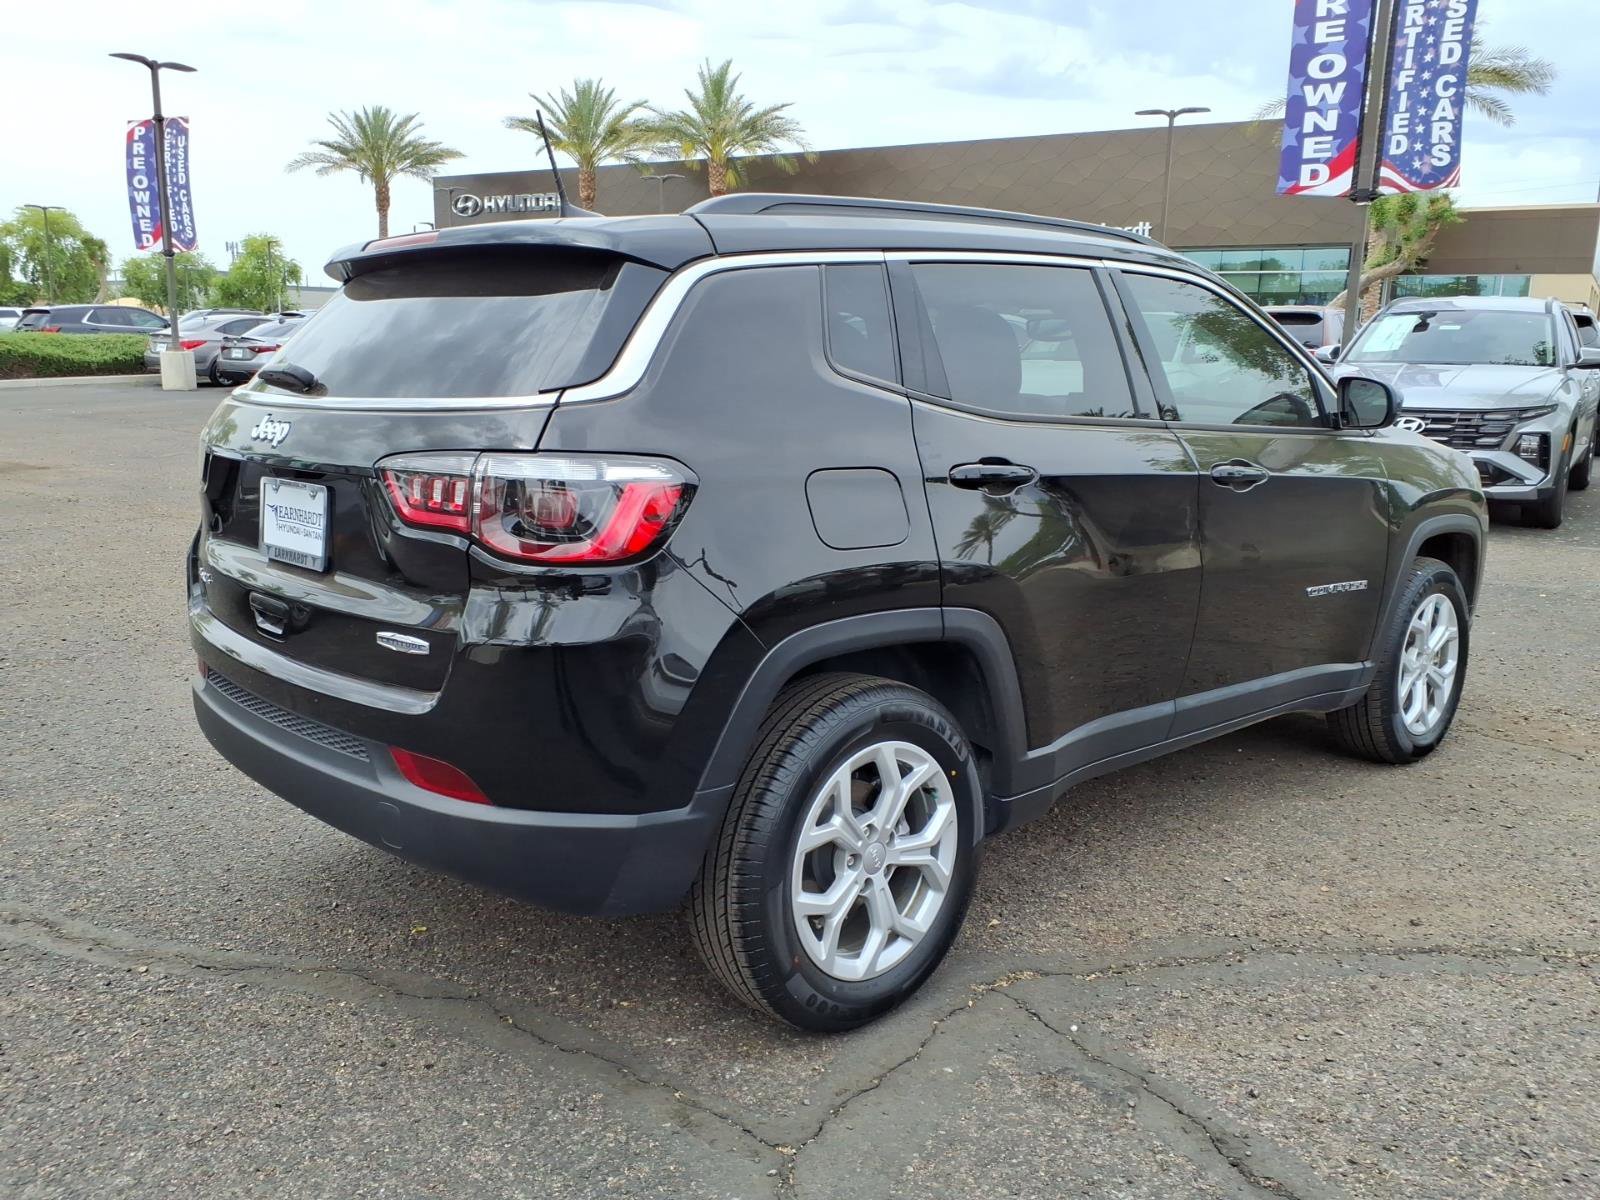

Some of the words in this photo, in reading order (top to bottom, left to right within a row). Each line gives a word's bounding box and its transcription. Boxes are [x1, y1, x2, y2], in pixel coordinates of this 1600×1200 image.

[1389, 0, 1426, 155] RTIFIED
[132, 126, 146, 170] PRE
[1299, 53, 1347, 187] OWNED
[1430, 74, 1458, 167] CARS
[164, 128, 178, 232] CERTIFIED
[177, 135, 186, 185] USED
[132, 175, 154, 247] OWNED
[179, 190, 194, 239] CARS
[252, 414, 291, 448] Jeep
[278, 505, 323, 527] EARNHARDT
